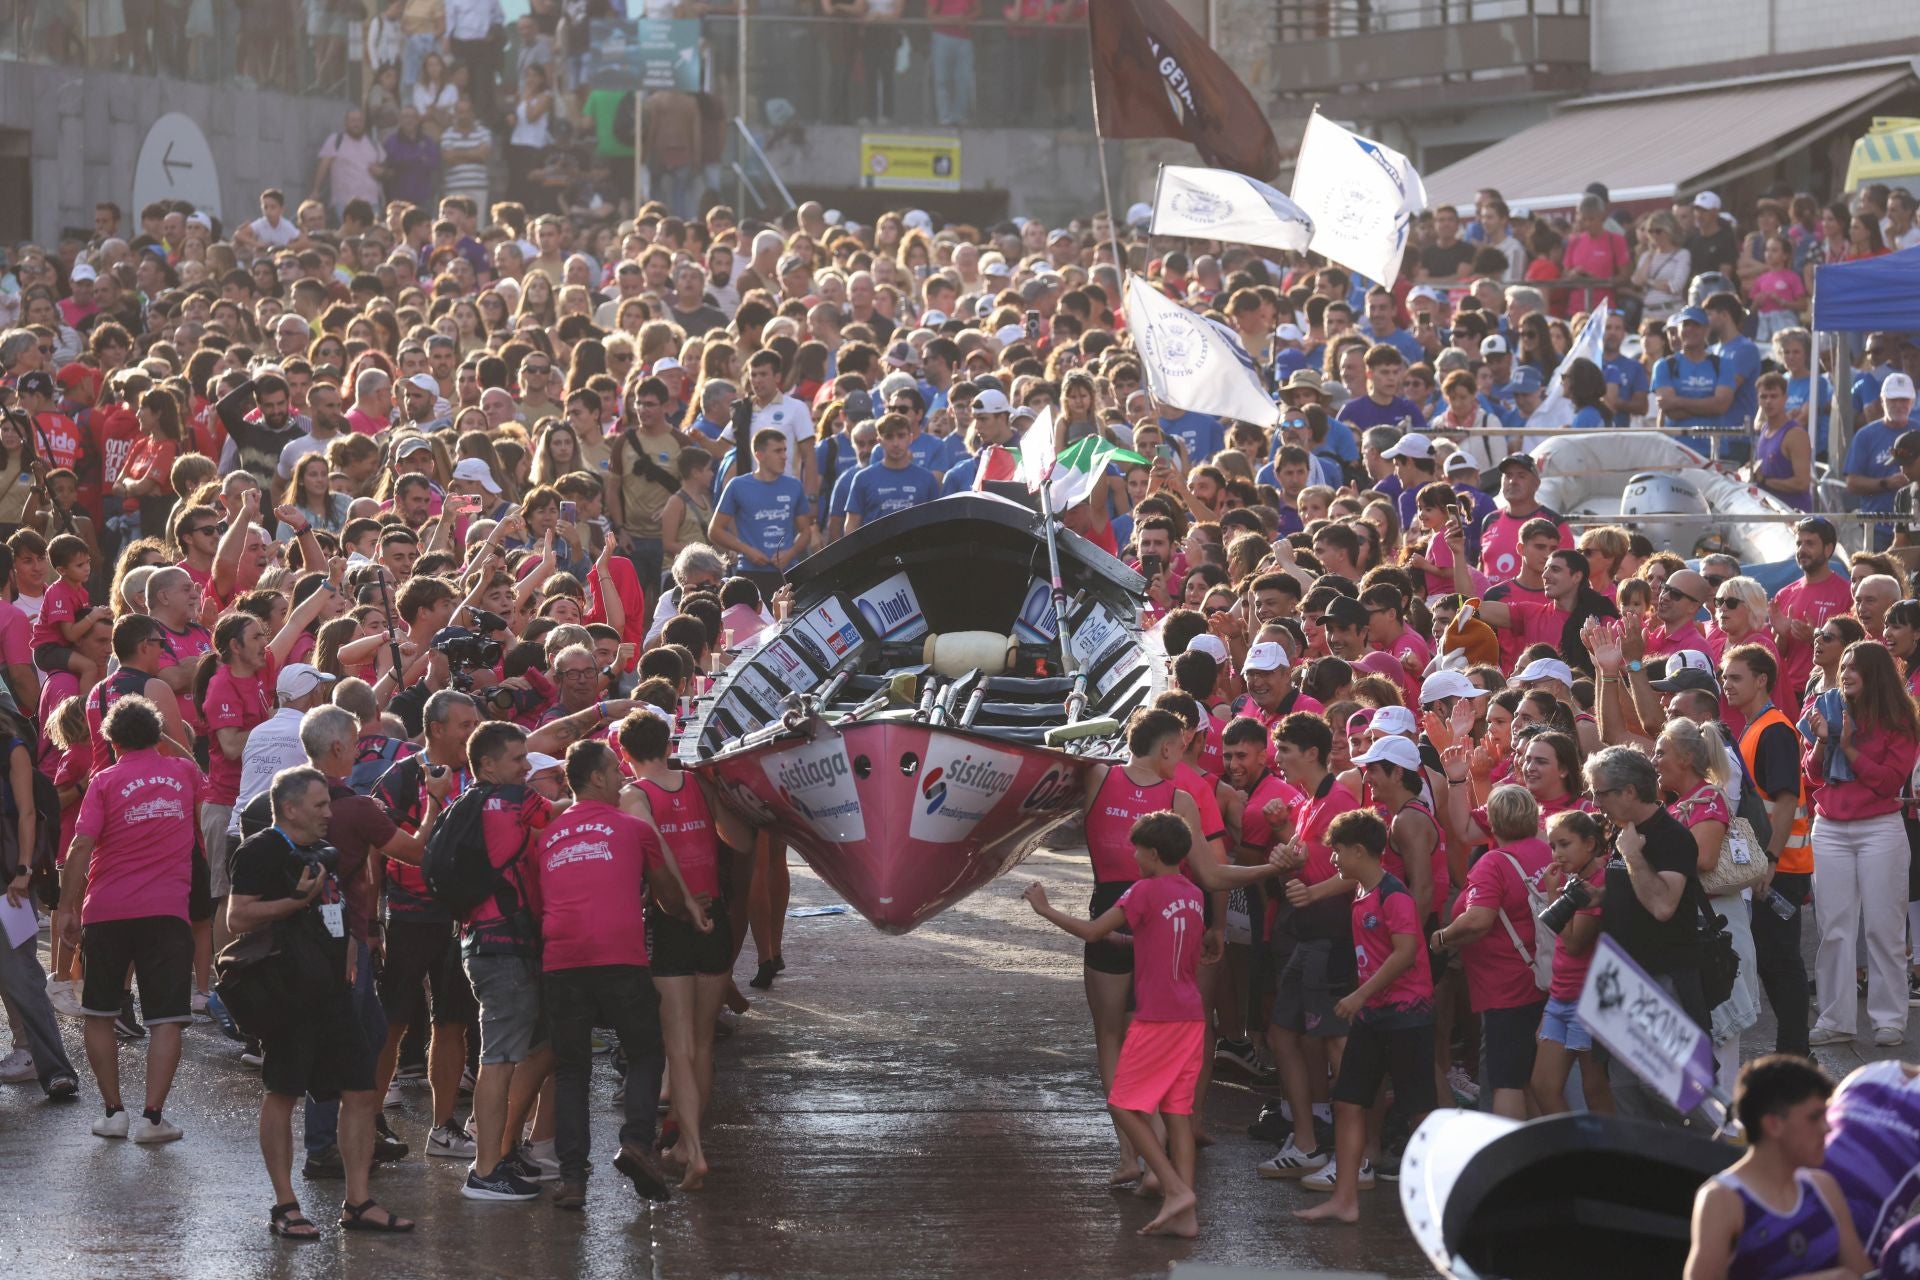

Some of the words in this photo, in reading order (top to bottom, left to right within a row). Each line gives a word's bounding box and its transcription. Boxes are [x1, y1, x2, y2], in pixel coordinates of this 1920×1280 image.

[878, 589, 912, 625] ilunki
[252, 756, 282, 765] EPAILEA
[254, 767, 274, 775] JUEZ
[779, 752, 848, 791] sistiaga
[946, 754, 1014, 797] sistiaga
[121, 778, 145, 797] SAN
[149, 776, 183, 791] JUAN
[1105, 806, 1129, 818] SAN
[576, 823, 615, 836] JUAN
[660, 824, 678, 834] SAN
[681, 820, 706, 832] JUAN
[1162, 899, 1186, 920] SAN
